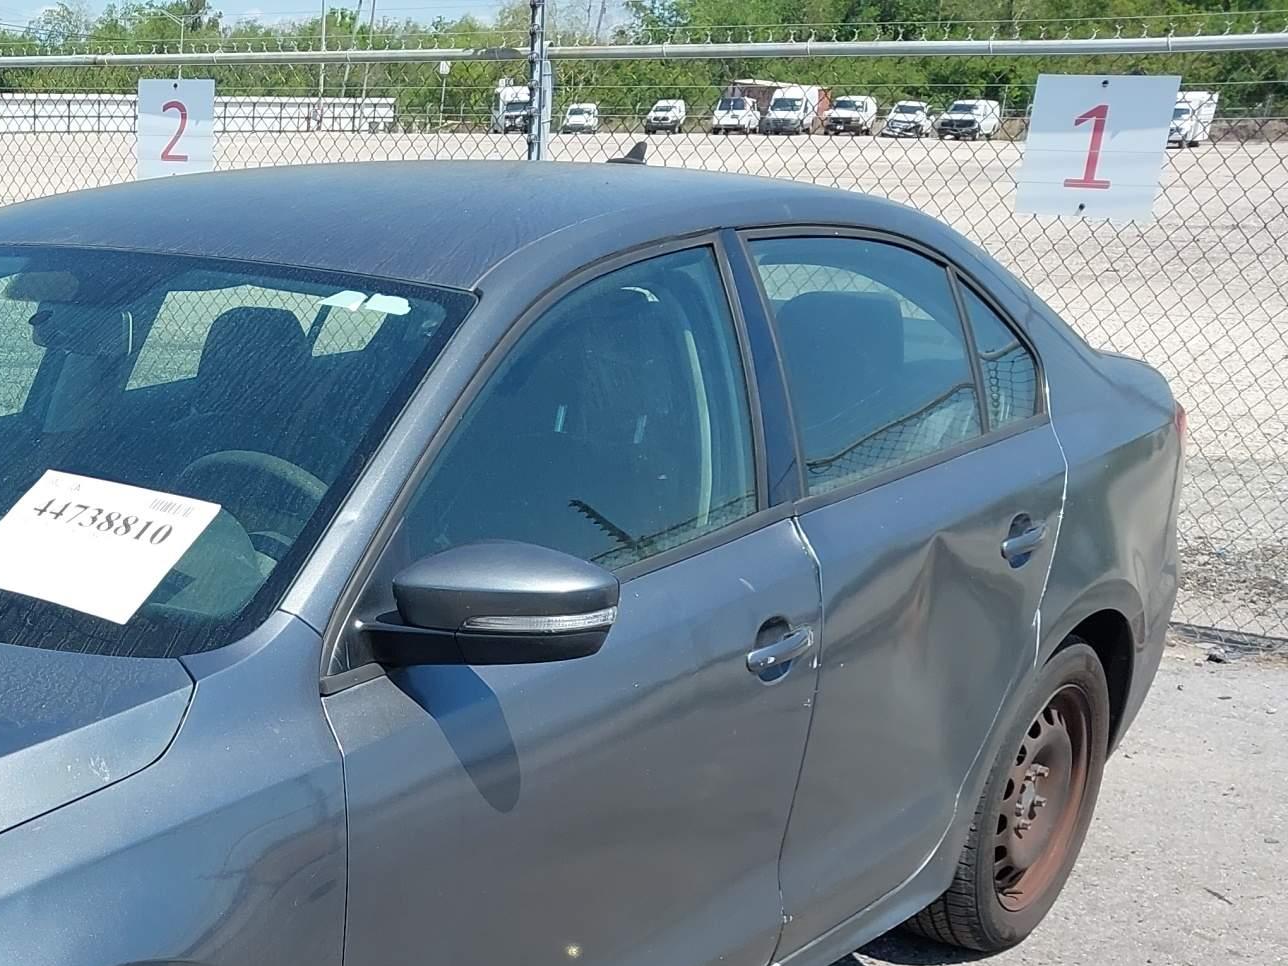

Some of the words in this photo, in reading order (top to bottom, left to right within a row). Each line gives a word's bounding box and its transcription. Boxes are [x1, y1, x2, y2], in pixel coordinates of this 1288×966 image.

[161, 100, 188, 161] 2
[1063, 104, 1111, 189] 1
[33, 498, 173, 545] 44738810
